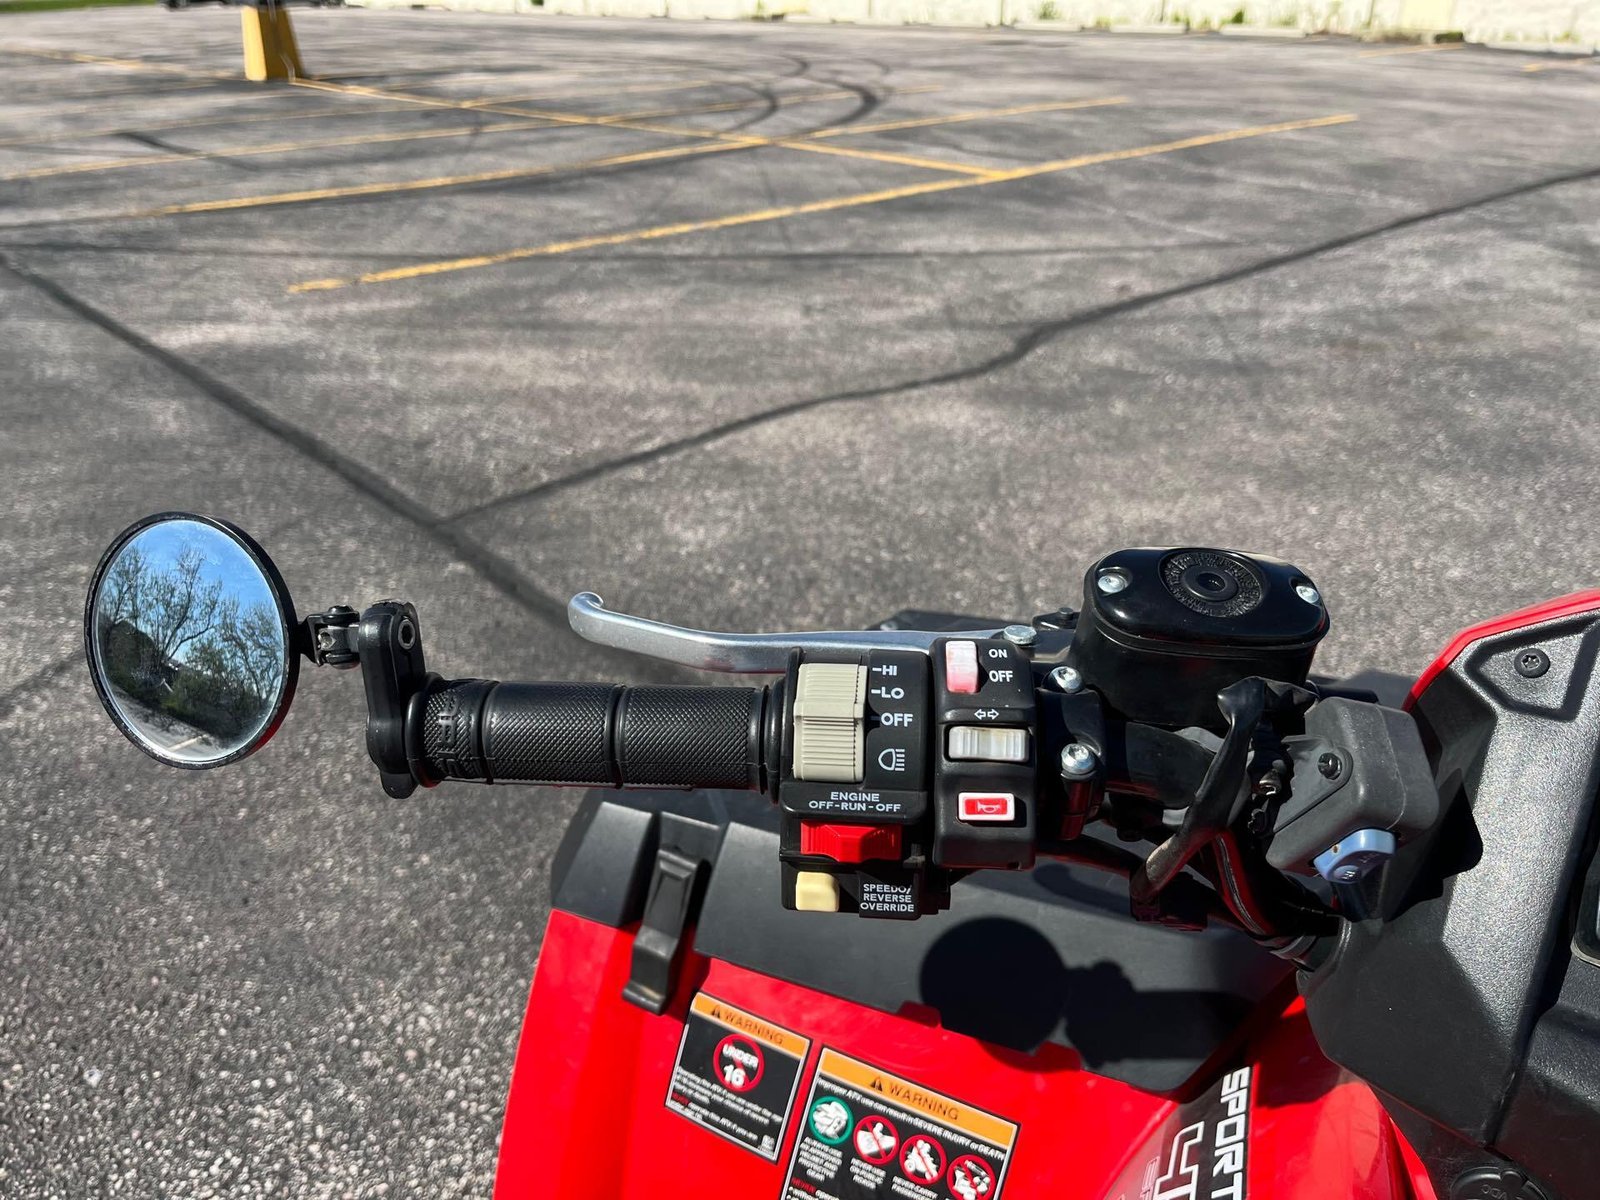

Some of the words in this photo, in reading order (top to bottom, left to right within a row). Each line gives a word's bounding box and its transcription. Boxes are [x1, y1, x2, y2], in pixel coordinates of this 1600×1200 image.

[988, 648, 1008, 658] ON
[988, 670, 1013, 682] OFF
[881, 713, 913, 727] OFF
[830, 791, 880, 802] ENGINE
[863, 893, 912, 903] REVERSE
[860, 902, 914, 912] OVERRIDE
[725, 1010, 785, 1045] WARNING
[722, 1043, 759, 1070] UNDER
[723, 1064, 746, 1088] 16
[890, 1083, 960, 1120] WARNING
[1211, 1066, 1250, 1200] SPORT
